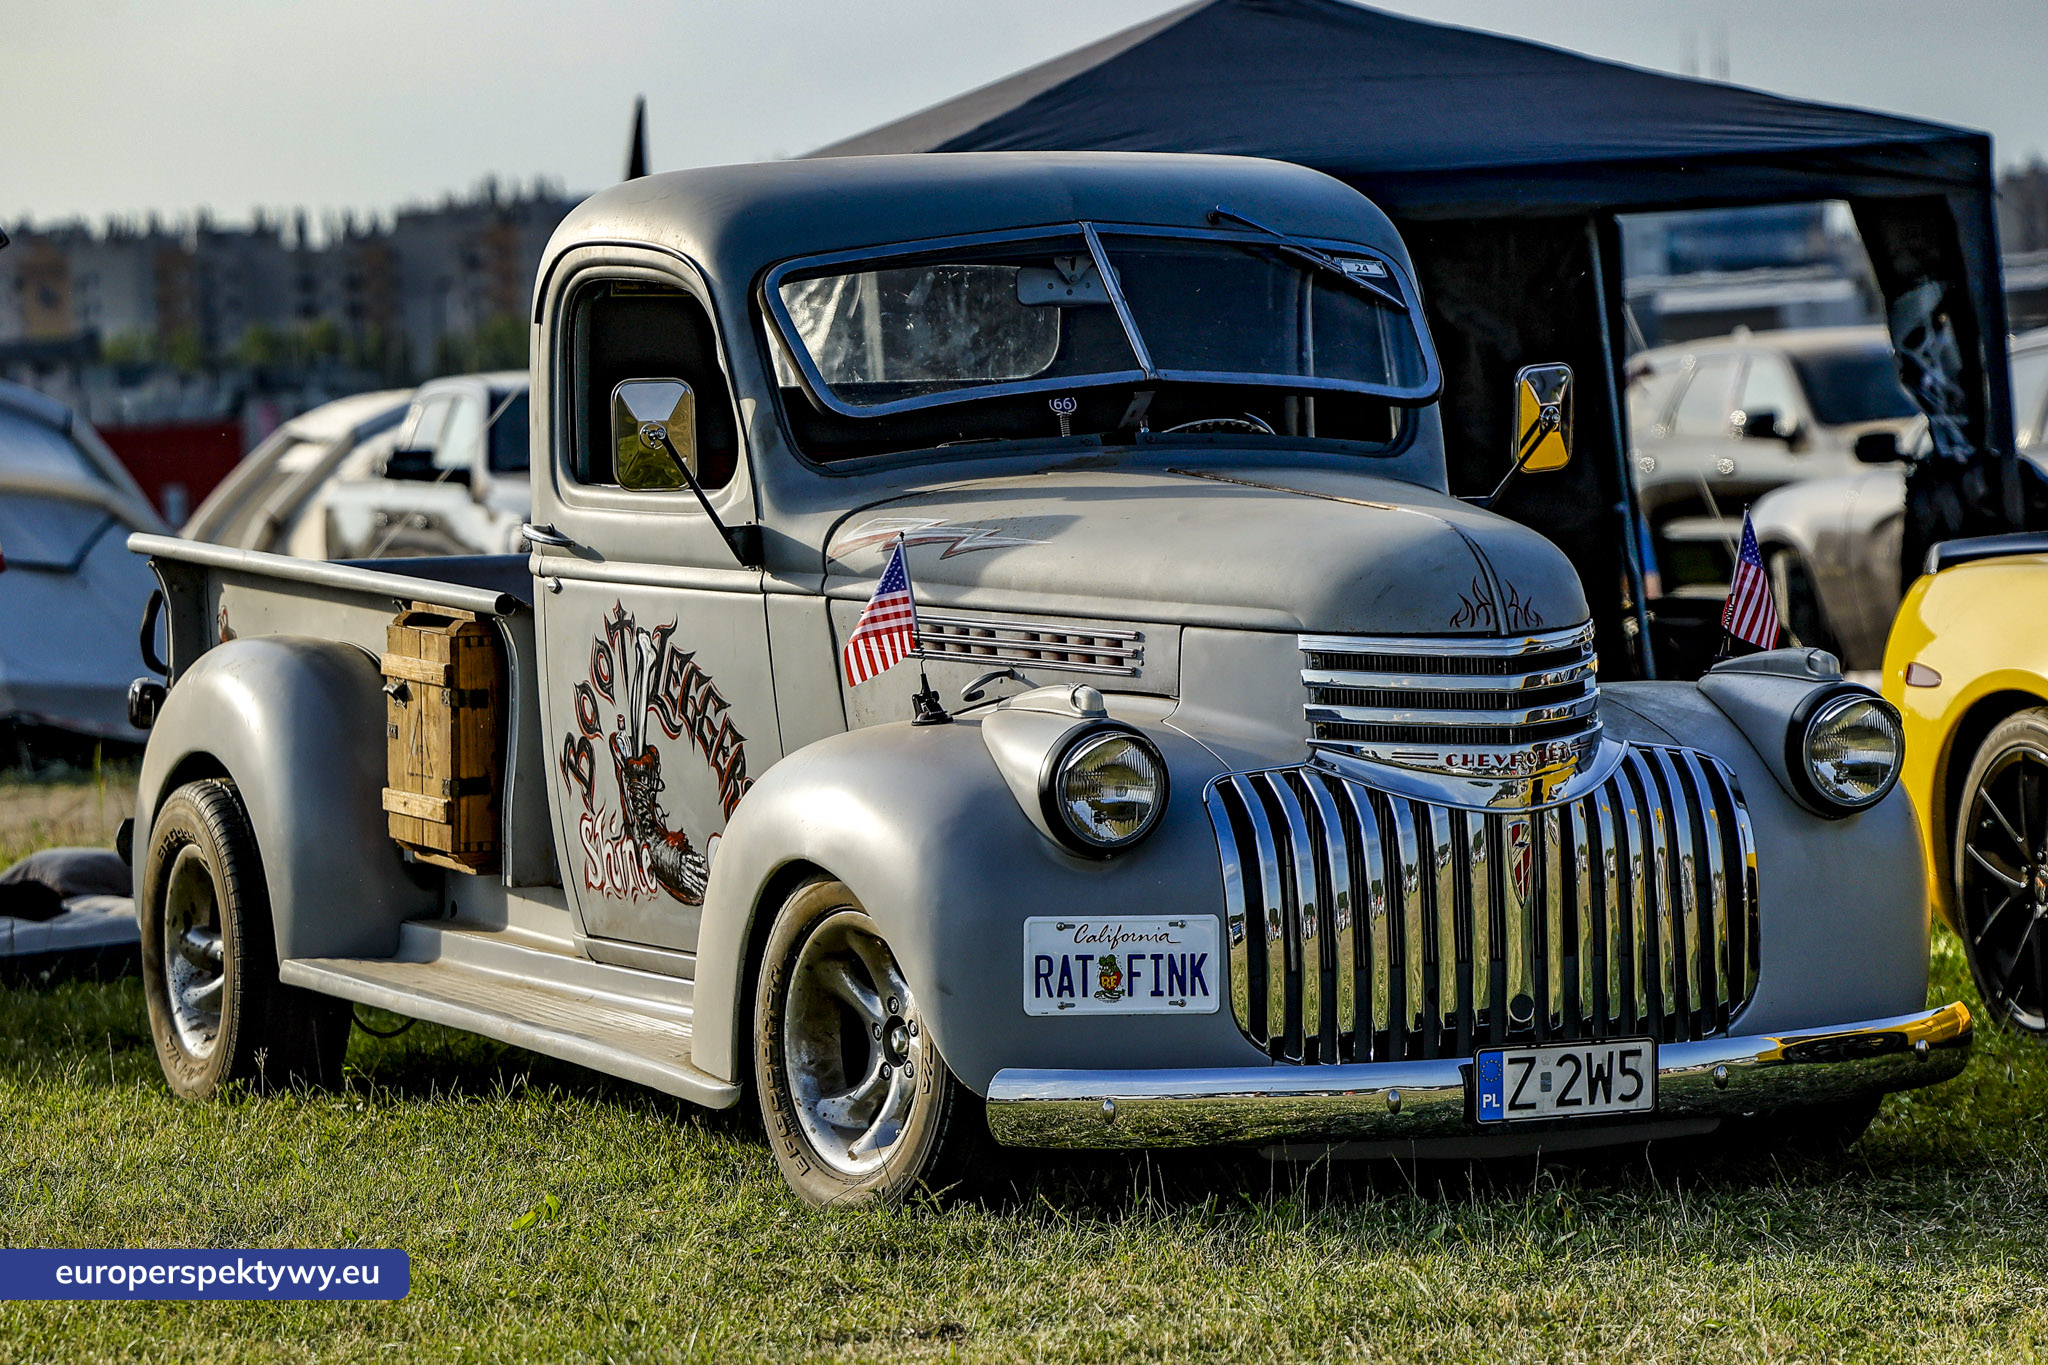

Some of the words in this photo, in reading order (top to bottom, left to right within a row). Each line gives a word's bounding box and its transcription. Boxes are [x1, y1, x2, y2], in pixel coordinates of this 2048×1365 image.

[1053, 397, 1072, 410] 66
[1446, 742, 1571, 768] CHEVROLET
[1073, 923, 1182, 950] California
[1034, 954, 1095, 998] RAT
[1127, 952, 1210, 997] FINK
[1508, 1056, 1537, 1112] Z
[1555, 1049, 1643, 1107] 2W5
[1482, 1093, 1500, 1108] PL
